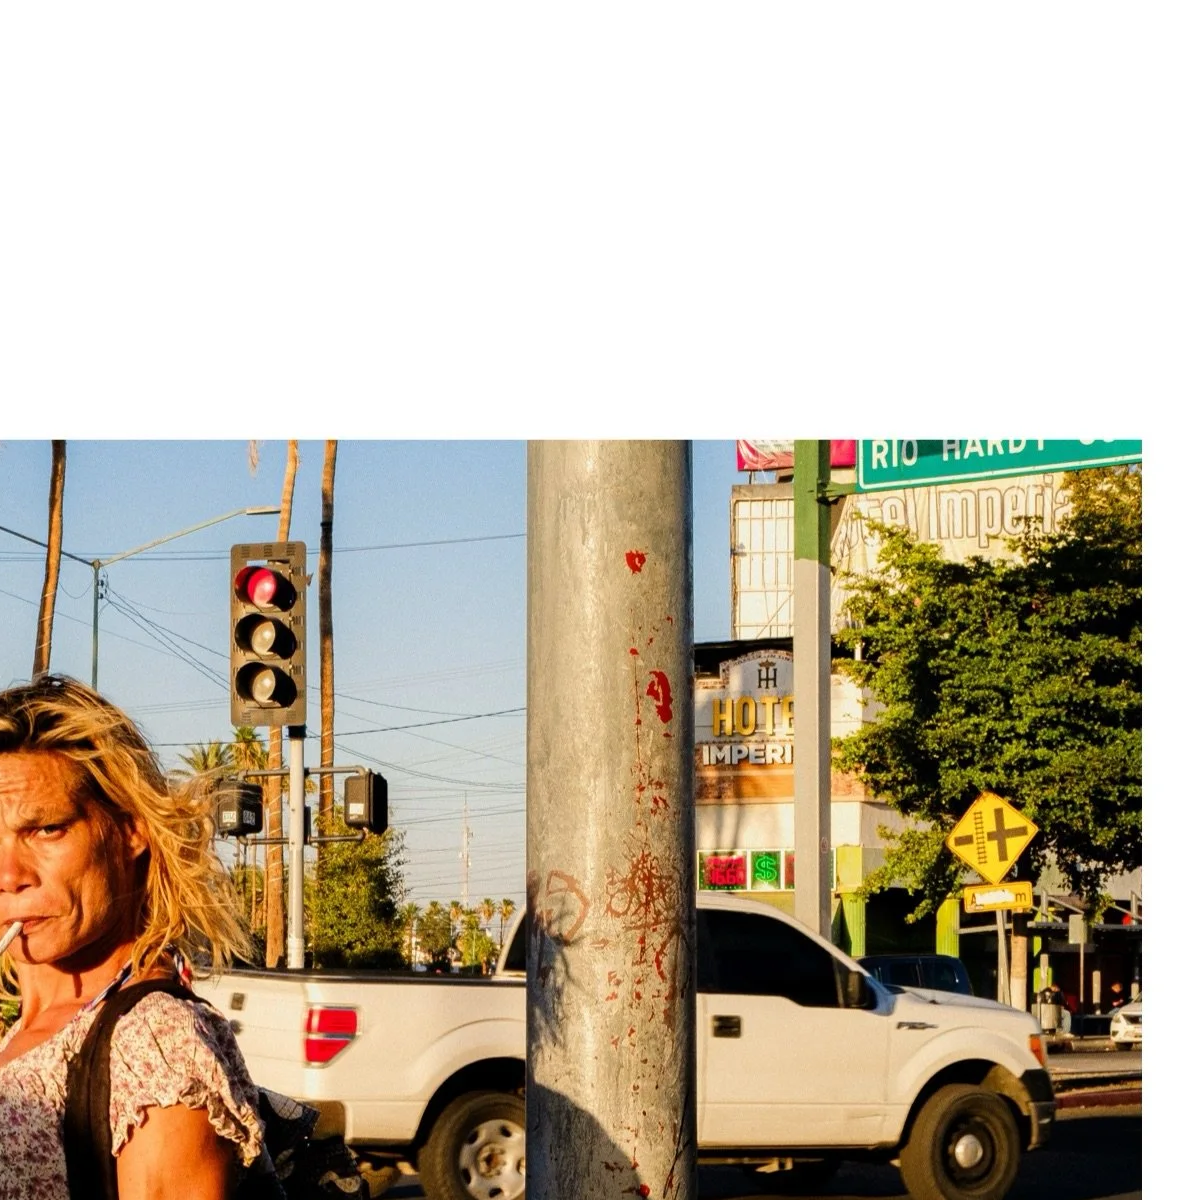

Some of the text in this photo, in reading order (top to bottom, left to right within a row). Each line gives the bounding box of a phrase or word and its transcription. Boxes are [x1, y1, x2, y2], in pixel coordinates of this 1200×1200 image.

[872, 440, 918, 470] RIO
[928, 475, 1074, 548] Imperia
[712, 694, 794, 738] HOTE
[702, 744, 794, 765] IMPERI
